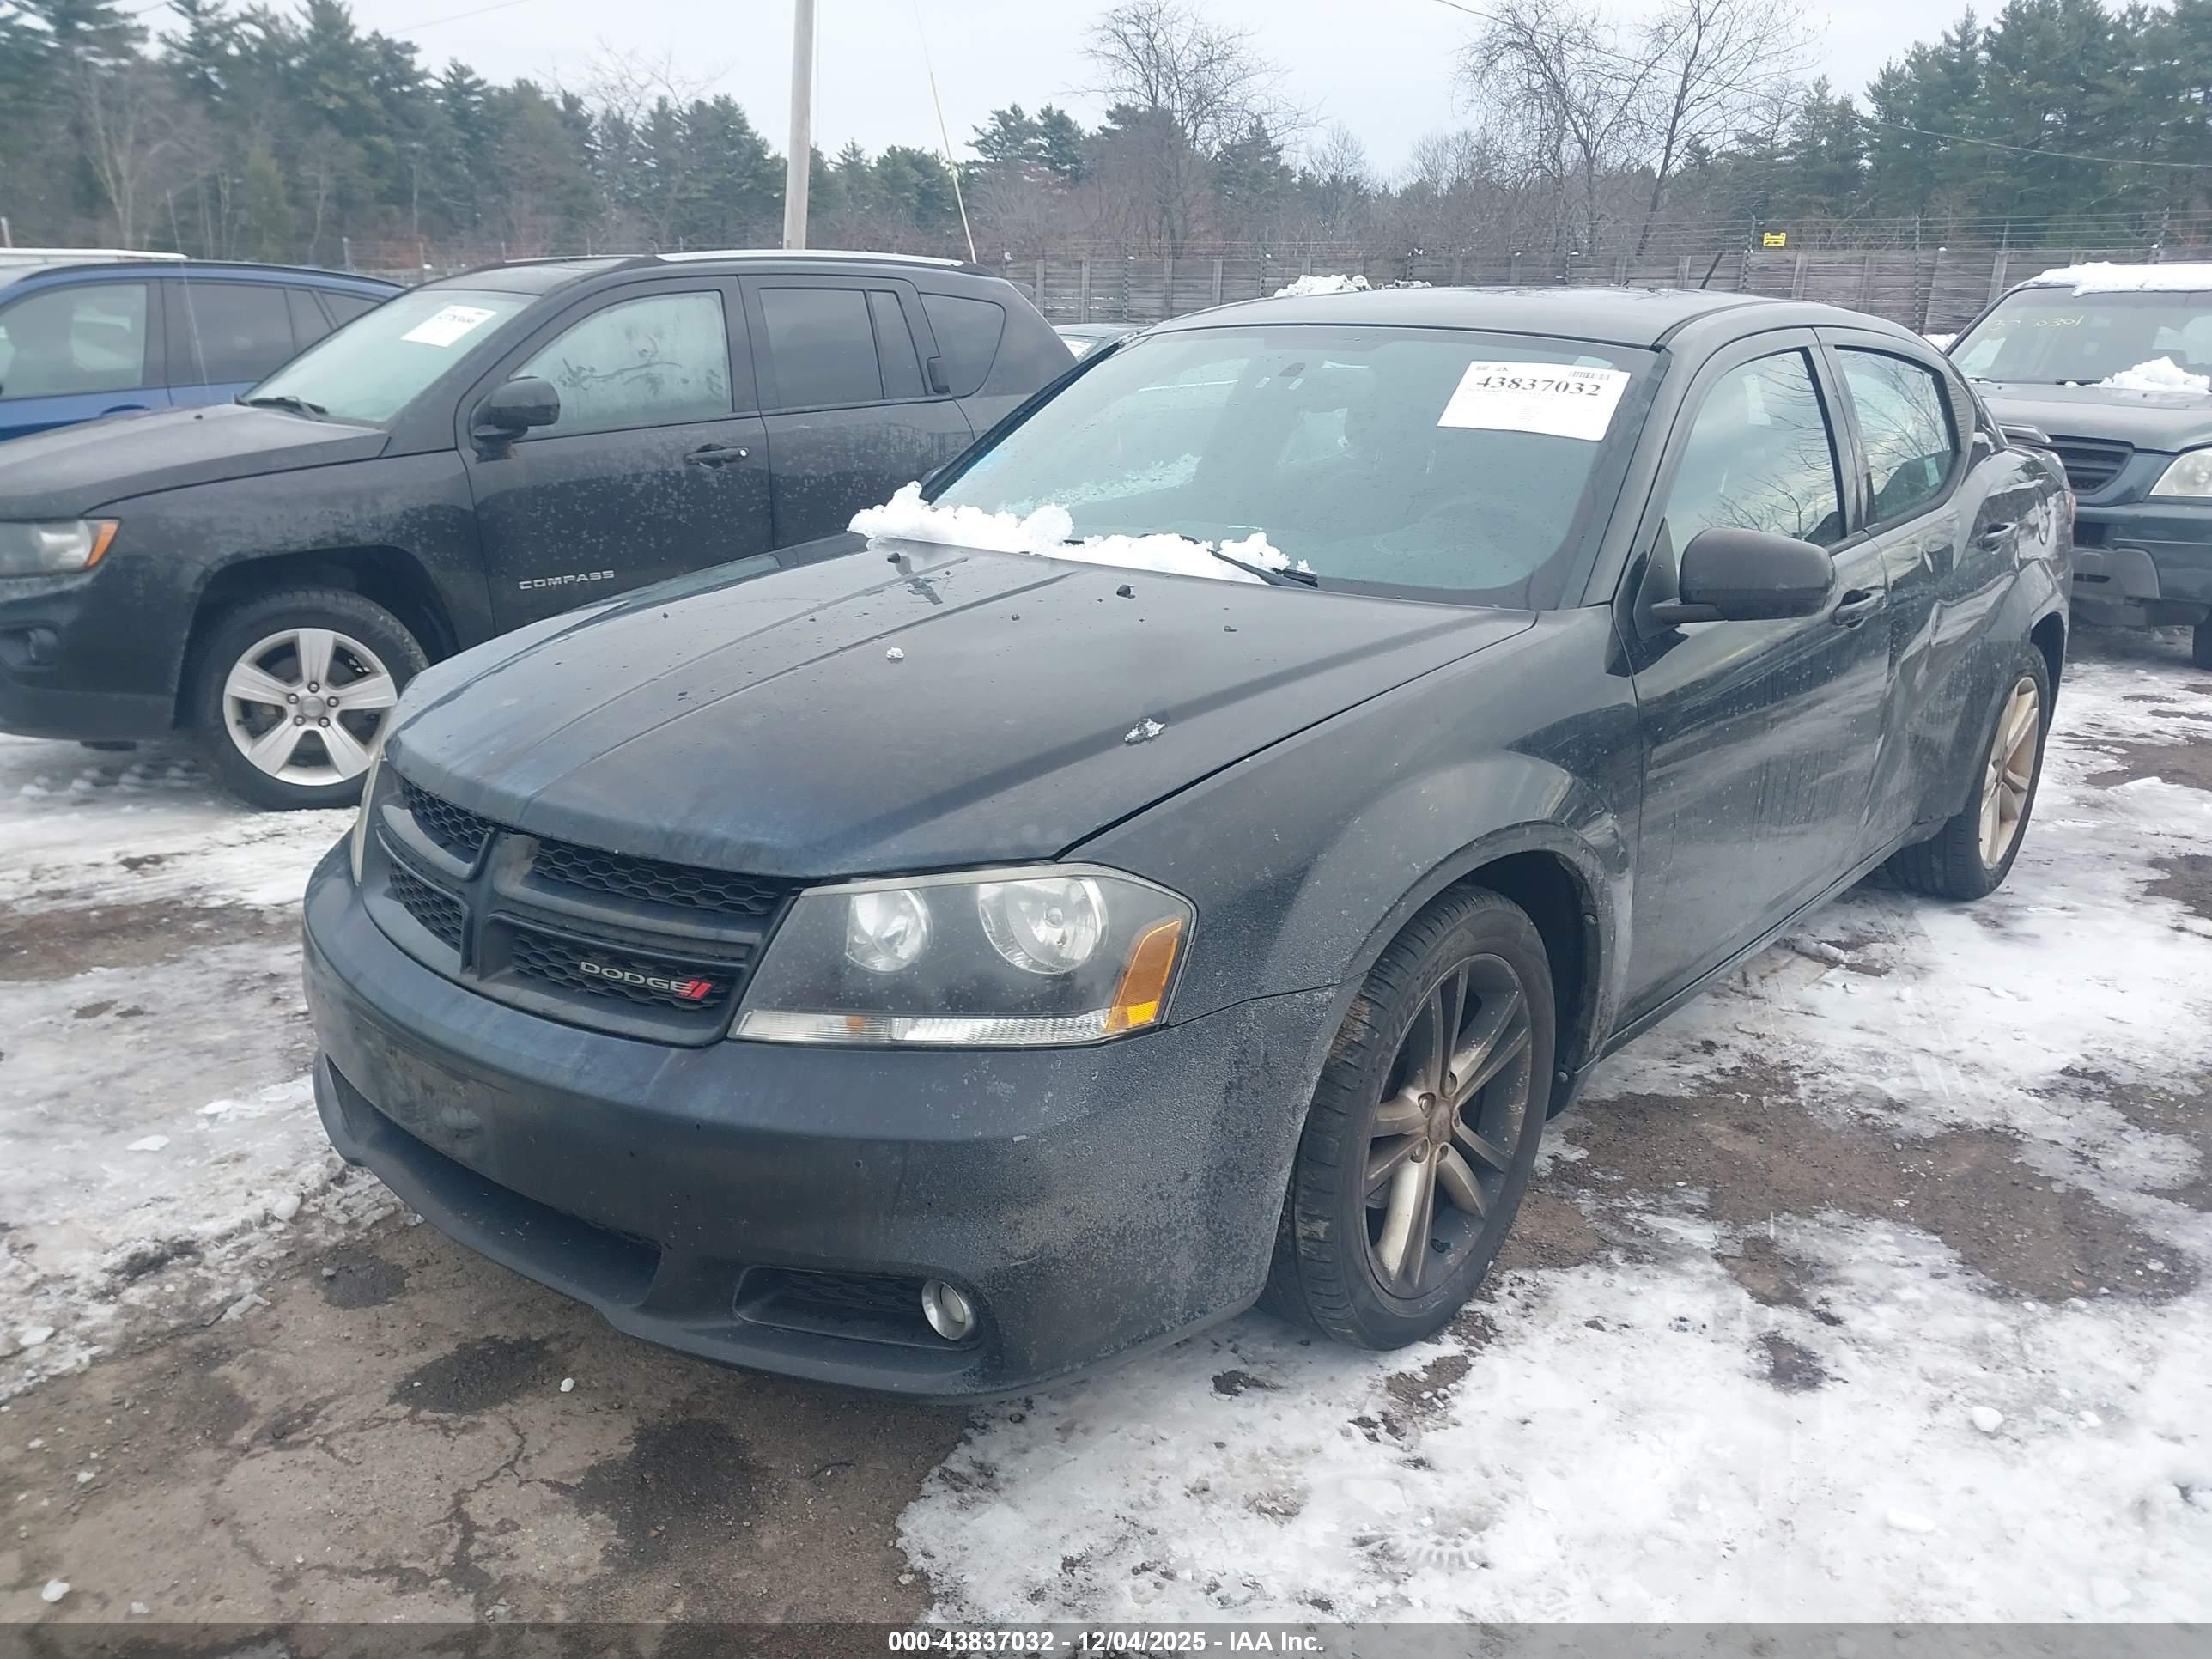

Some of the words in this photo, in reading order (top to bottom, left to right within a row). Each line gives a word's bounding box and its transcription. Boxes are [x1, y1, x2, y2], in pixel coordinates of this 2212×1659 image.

[1476, 375, 1601, 397] 43837032
[518, 570, 615, 590] COMPASS
[580, 961, 692, 994] DODGE
